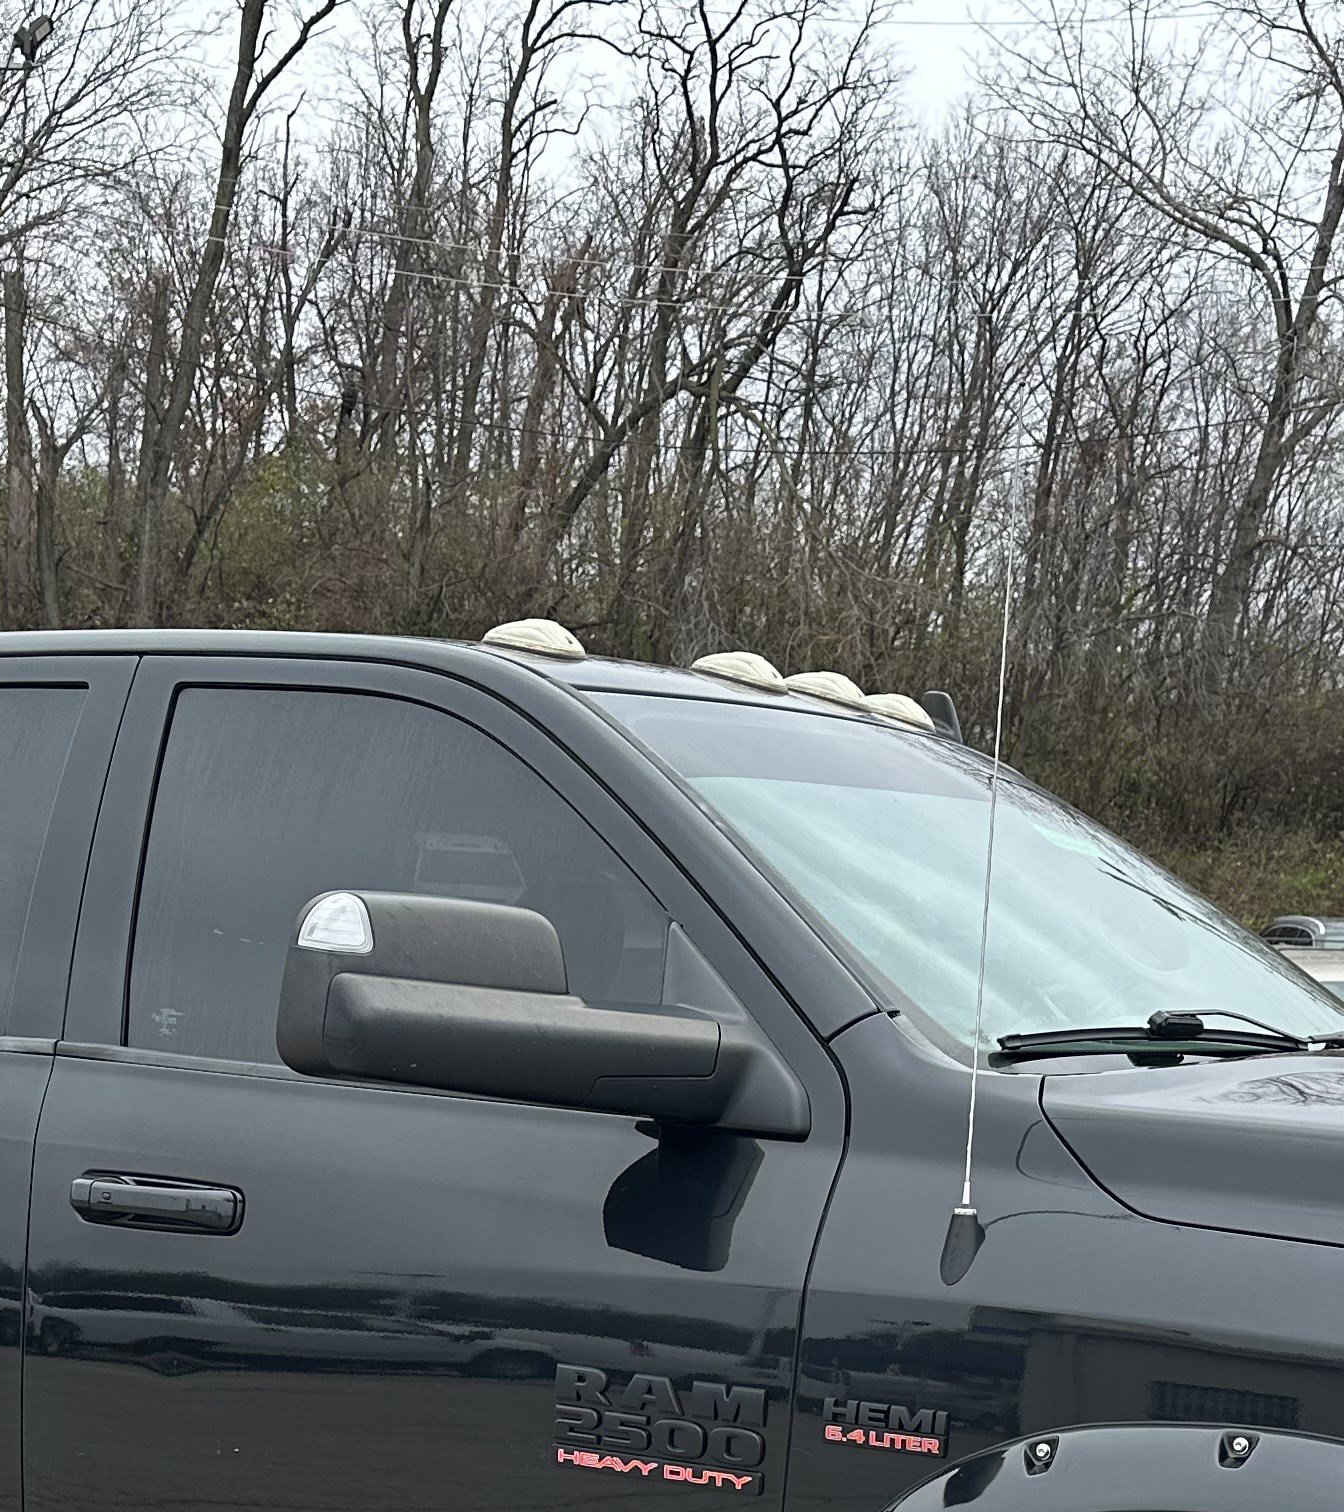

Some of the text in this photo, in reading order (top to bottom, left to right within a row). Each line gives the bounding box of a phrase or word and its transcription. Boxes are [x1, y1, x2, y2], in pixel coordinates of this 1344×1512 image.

[556, 1362, 768, 1428] RAM
[823, 1396, 949, 1435] HEMI
[554, 1402, 766, 1467] 2500
[824, 1425, 940, 1455] 6.4 LITER
[556, 1448, 752, 1490] HEAVY DUTY
